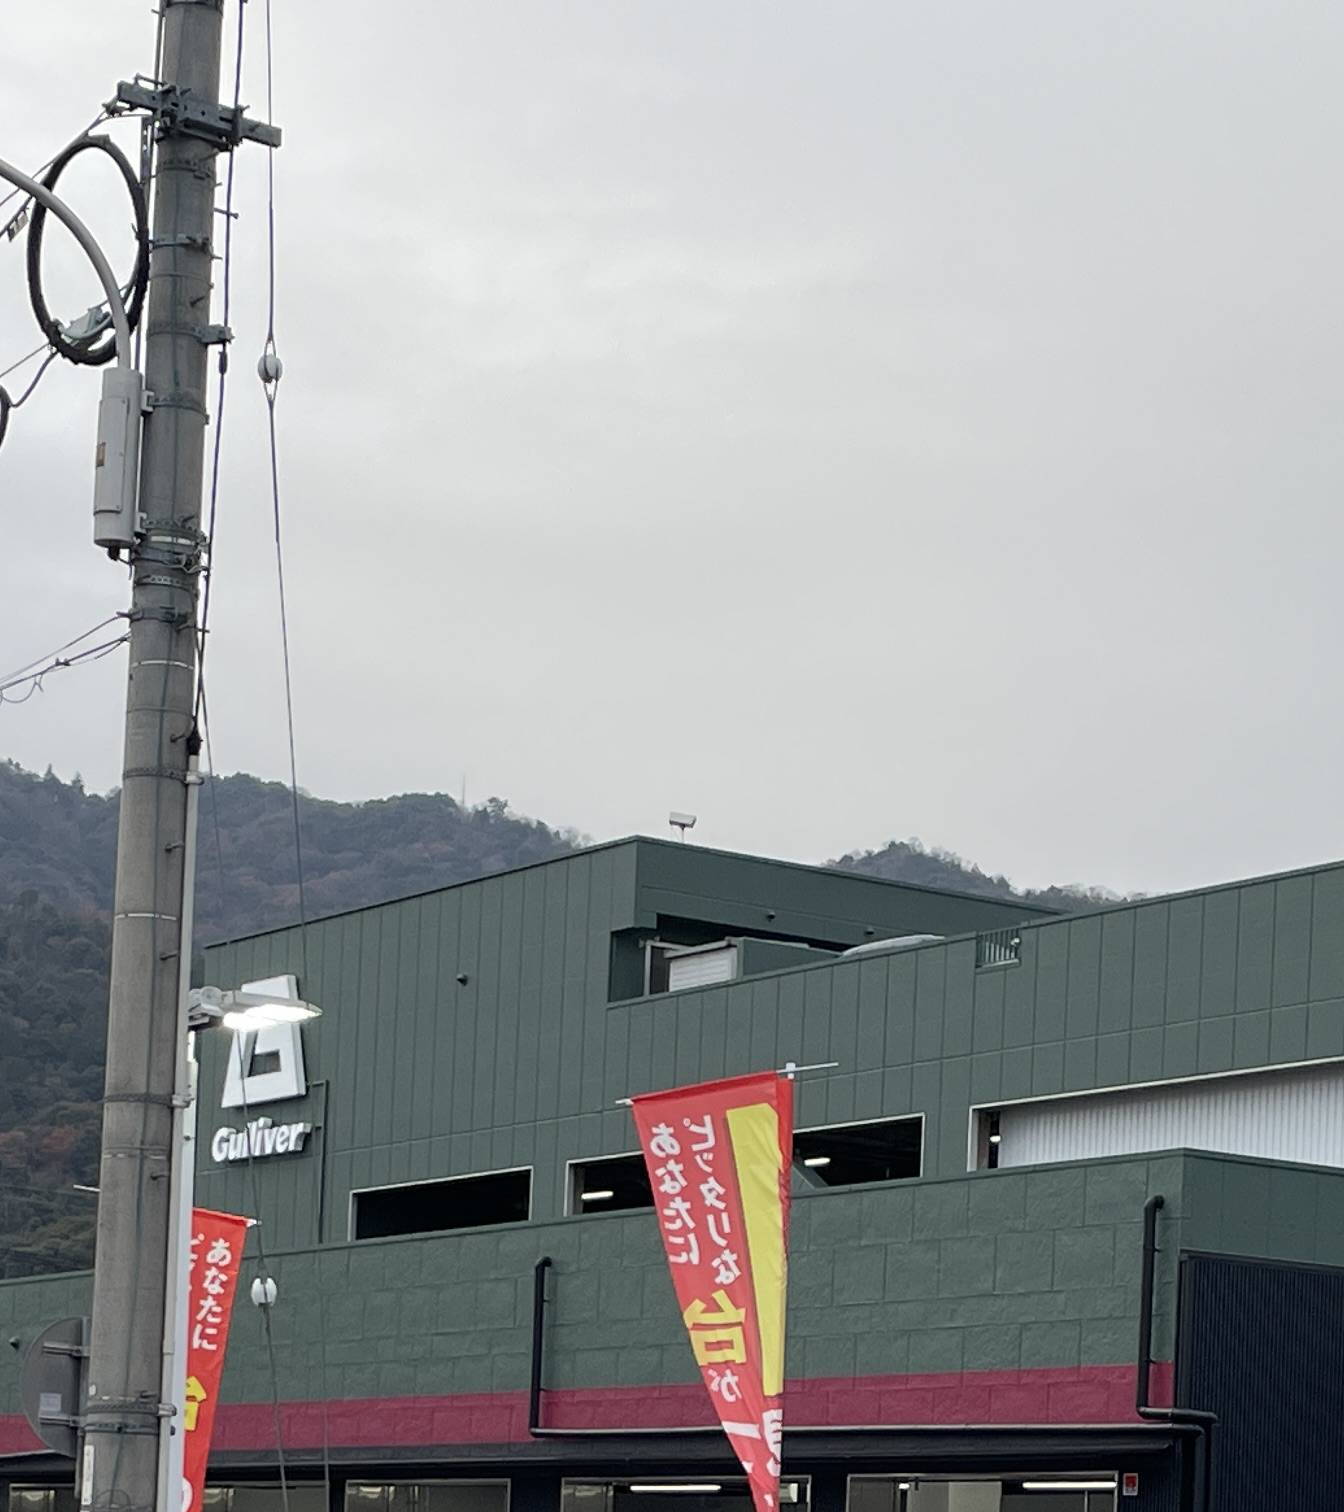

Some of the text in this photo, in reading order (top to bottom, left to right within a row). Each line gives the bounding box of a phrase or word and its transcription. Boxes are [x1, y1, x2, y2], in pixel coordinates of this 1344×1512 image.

[212, 1116, 312, 1162] Gulliver
[192, 1238, 232, 1351] あなたに
